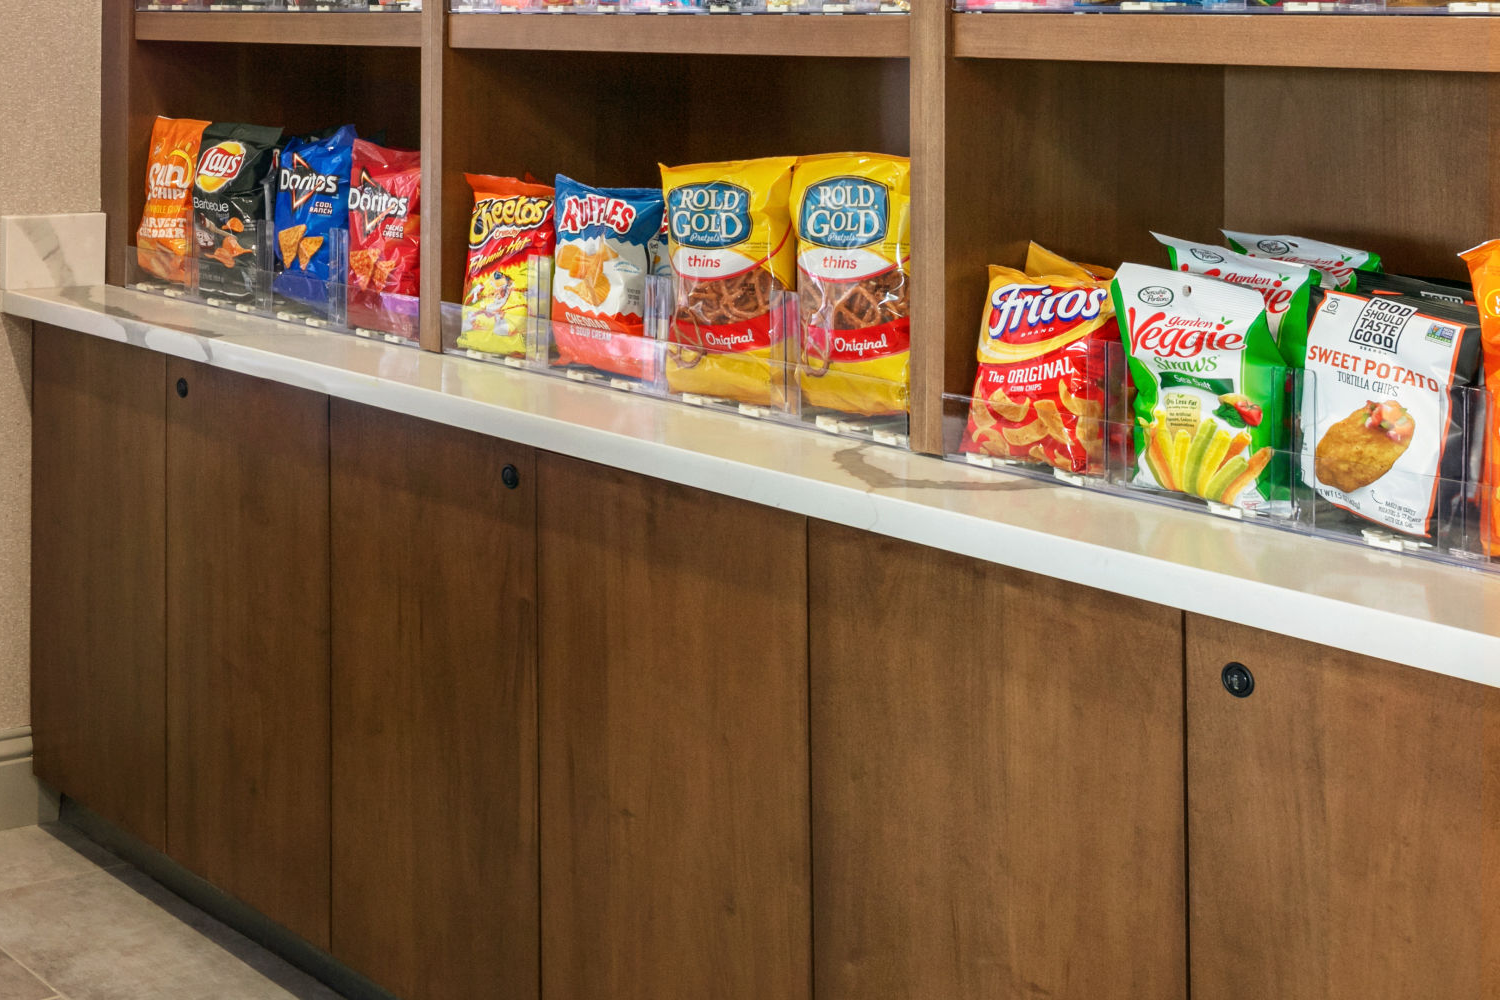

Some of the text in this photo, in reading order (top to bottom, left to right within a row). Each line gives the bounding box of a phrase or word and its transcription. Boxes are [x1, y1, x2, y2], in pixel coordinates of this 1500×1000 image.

[202, 147, 244, 177] Lay's
[280, 168, 338, 193] Doritos
[148, 187, 186, 200] CHIPS
[348, 187, 408, 217] Doritos
[680, 188, 740, 211] ROLD
[819, 185, 875, 210] ROLD
[469, 196, 550, 246] Cheetos
[558, 193, 637, 234] RUFFLES
[672, 209, 743, 238] GOLD
[806, 208, 880, 238] GOLD
[507, 237, 532, 253] Hot
[688, 255, 721, 268] thins
[823, 255, 858, 270] thins
[1224, 272, 1271, 286] garden
[988, 283, 1108, 339] Fritos
[1364, 309, 1404, 326] SHOULD
[1369, 299, 1413, 317] FOOD
[565, 311, 611, 330] CHEDDAR
[1165, 316, 1213, 329] garden
[1359, 318, 1399, 337] TASTE
[705, 329, 755, 348] Original
[1020, 327, 1055, 338] BRAND
[1128, 307, 1247, 359] Veggie
[1354, 328, 1394, 349] GOOD
[834, 334, 888, 356] Original
[988, 356, 1076, 384] The ORIGINAL
[1174, 374, 1192, 384] Sea
[1308, 345, 1439, 393] SWEET POTATO
[1025, 383, 1042, 392] CHIPS
[1336, 371, 1399, 397] TORTILLA CHIPS
